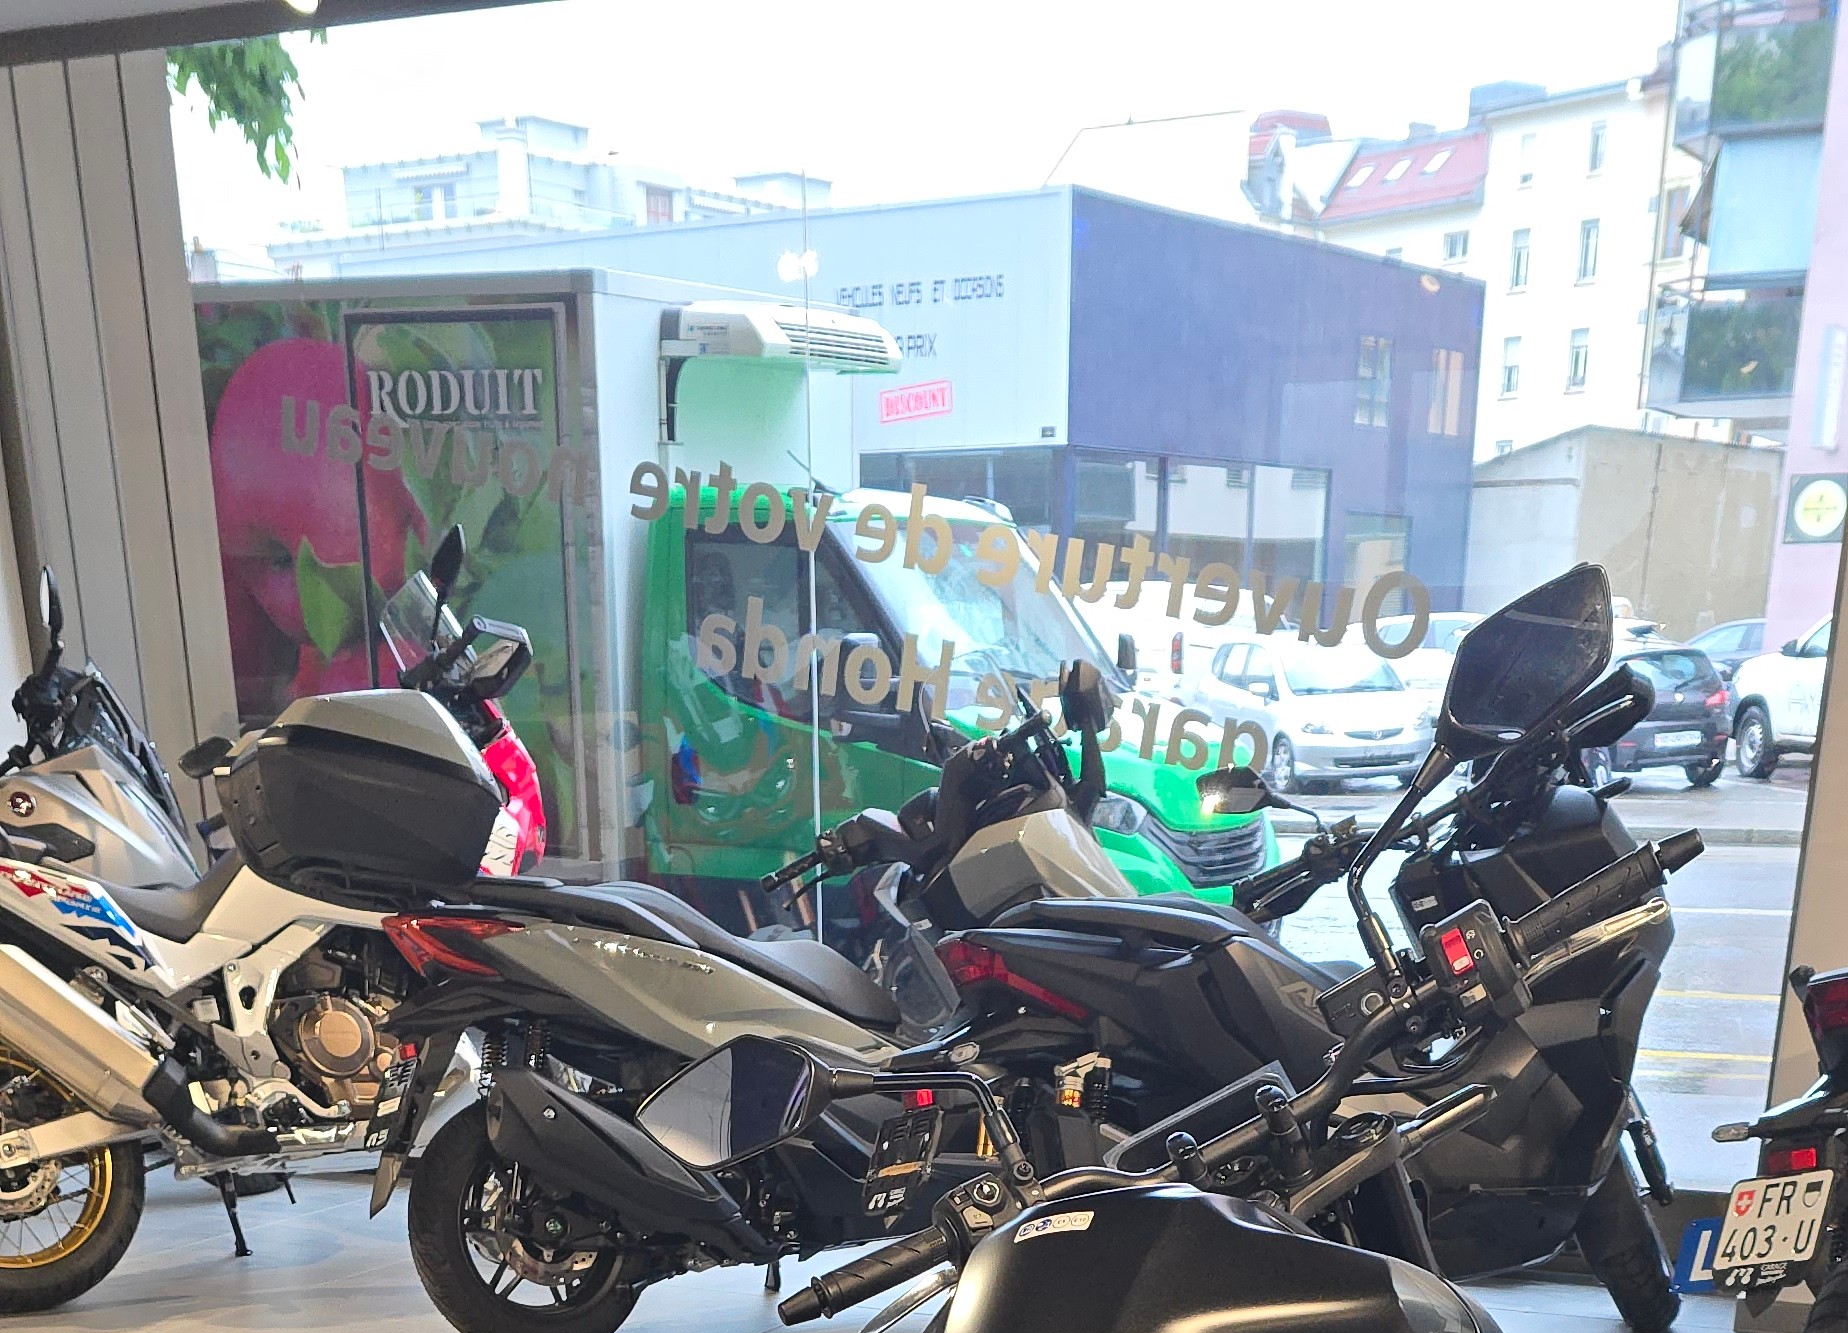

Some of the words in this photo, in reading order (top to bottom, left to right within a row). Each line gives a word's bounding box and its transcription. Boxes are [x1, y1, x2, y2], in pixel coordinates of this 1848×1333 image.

[932, 279, 946, 303] ET
[907, 333, 937, 358] PRIX
[367, 369, 543, 428] RODUIT
[884, 387, 946, 417] DISCOUNT
[1758, 1181, 1798, 1219] FR
[1689, 1230, 1714, 1281] L
